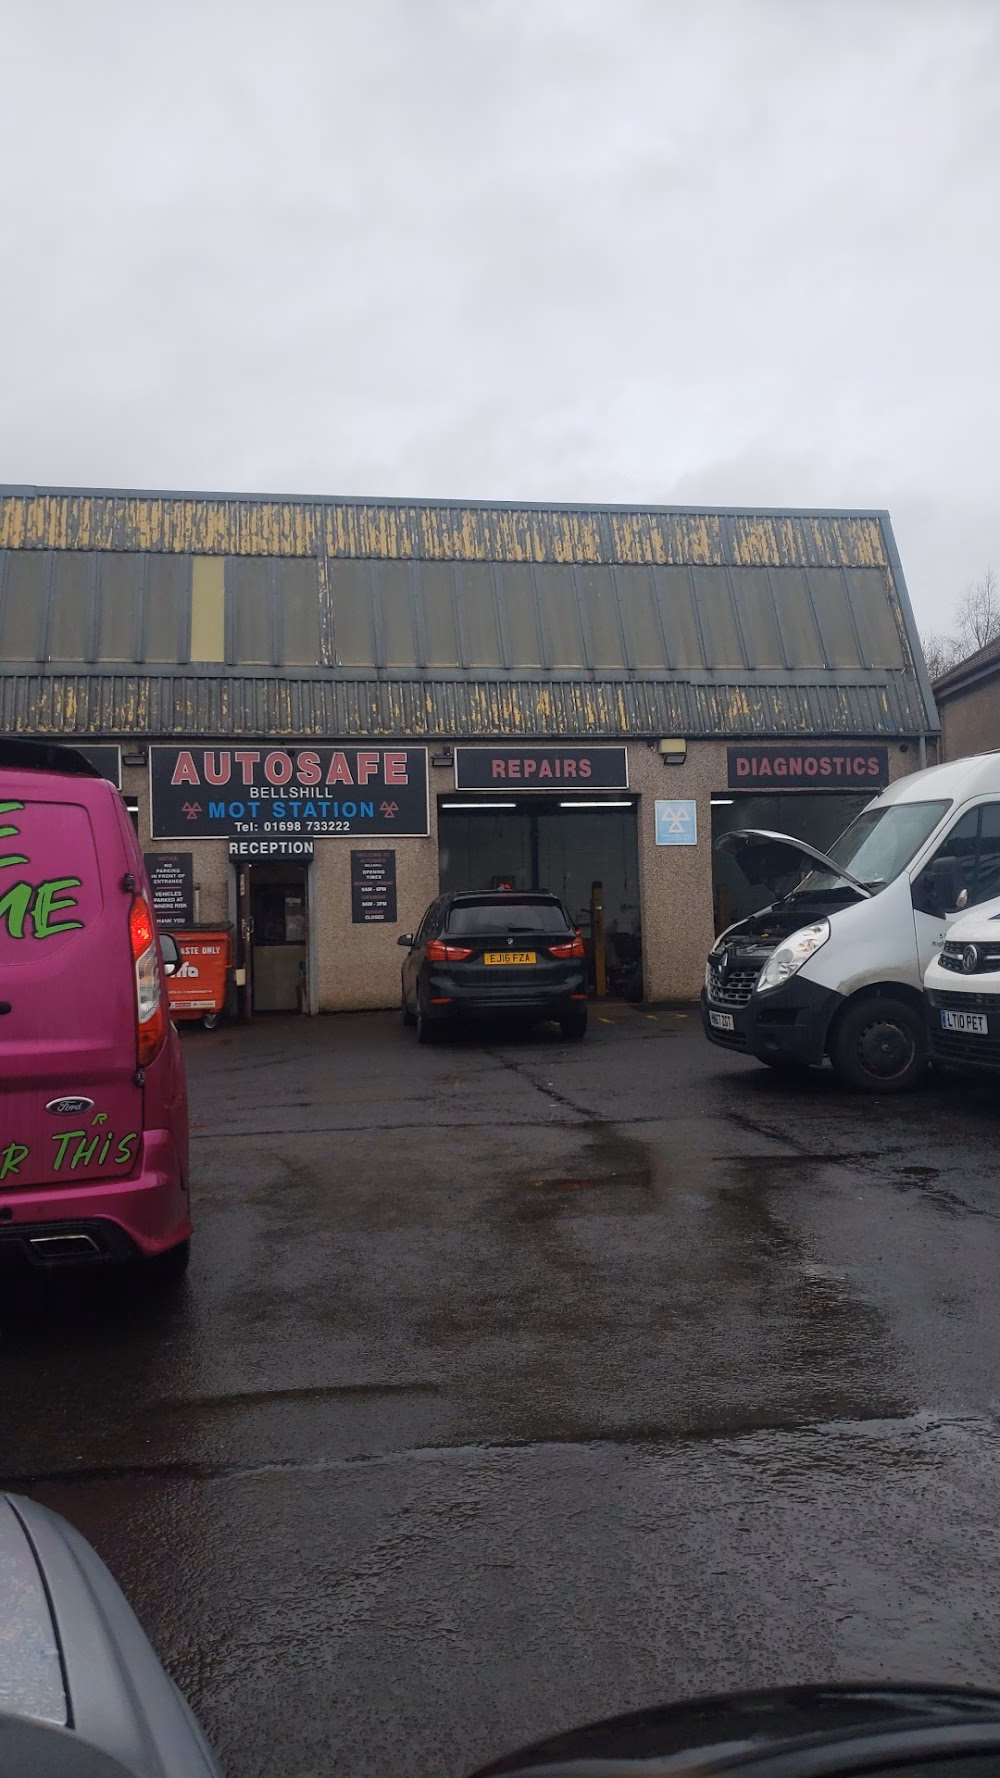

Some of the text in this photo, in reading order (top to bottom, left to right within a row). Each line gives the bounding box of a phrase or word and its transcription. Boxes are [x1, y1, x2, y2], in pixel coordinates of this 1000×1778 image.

[171, 751, 408, 785] AUTOSAFE
[491, 758, 592, 778] REPAIRS
[736, 756, 880, 776] DIAGNOSTICS
[250, 787, 333, 799] BELLSHILL
[208, 801, 375, 819] MOT STATION
[234, 821, 351, 832] Tel: 01698 733222
[229, 842, 314, 855] RECEPTION
[180, 946, 221, 955] ASTE ONLY
[490, 953, 530, 963] EJ16 FZA
[966, 1015, 983, 1031] PET
[57, 1100, 82, 1112] Ford
